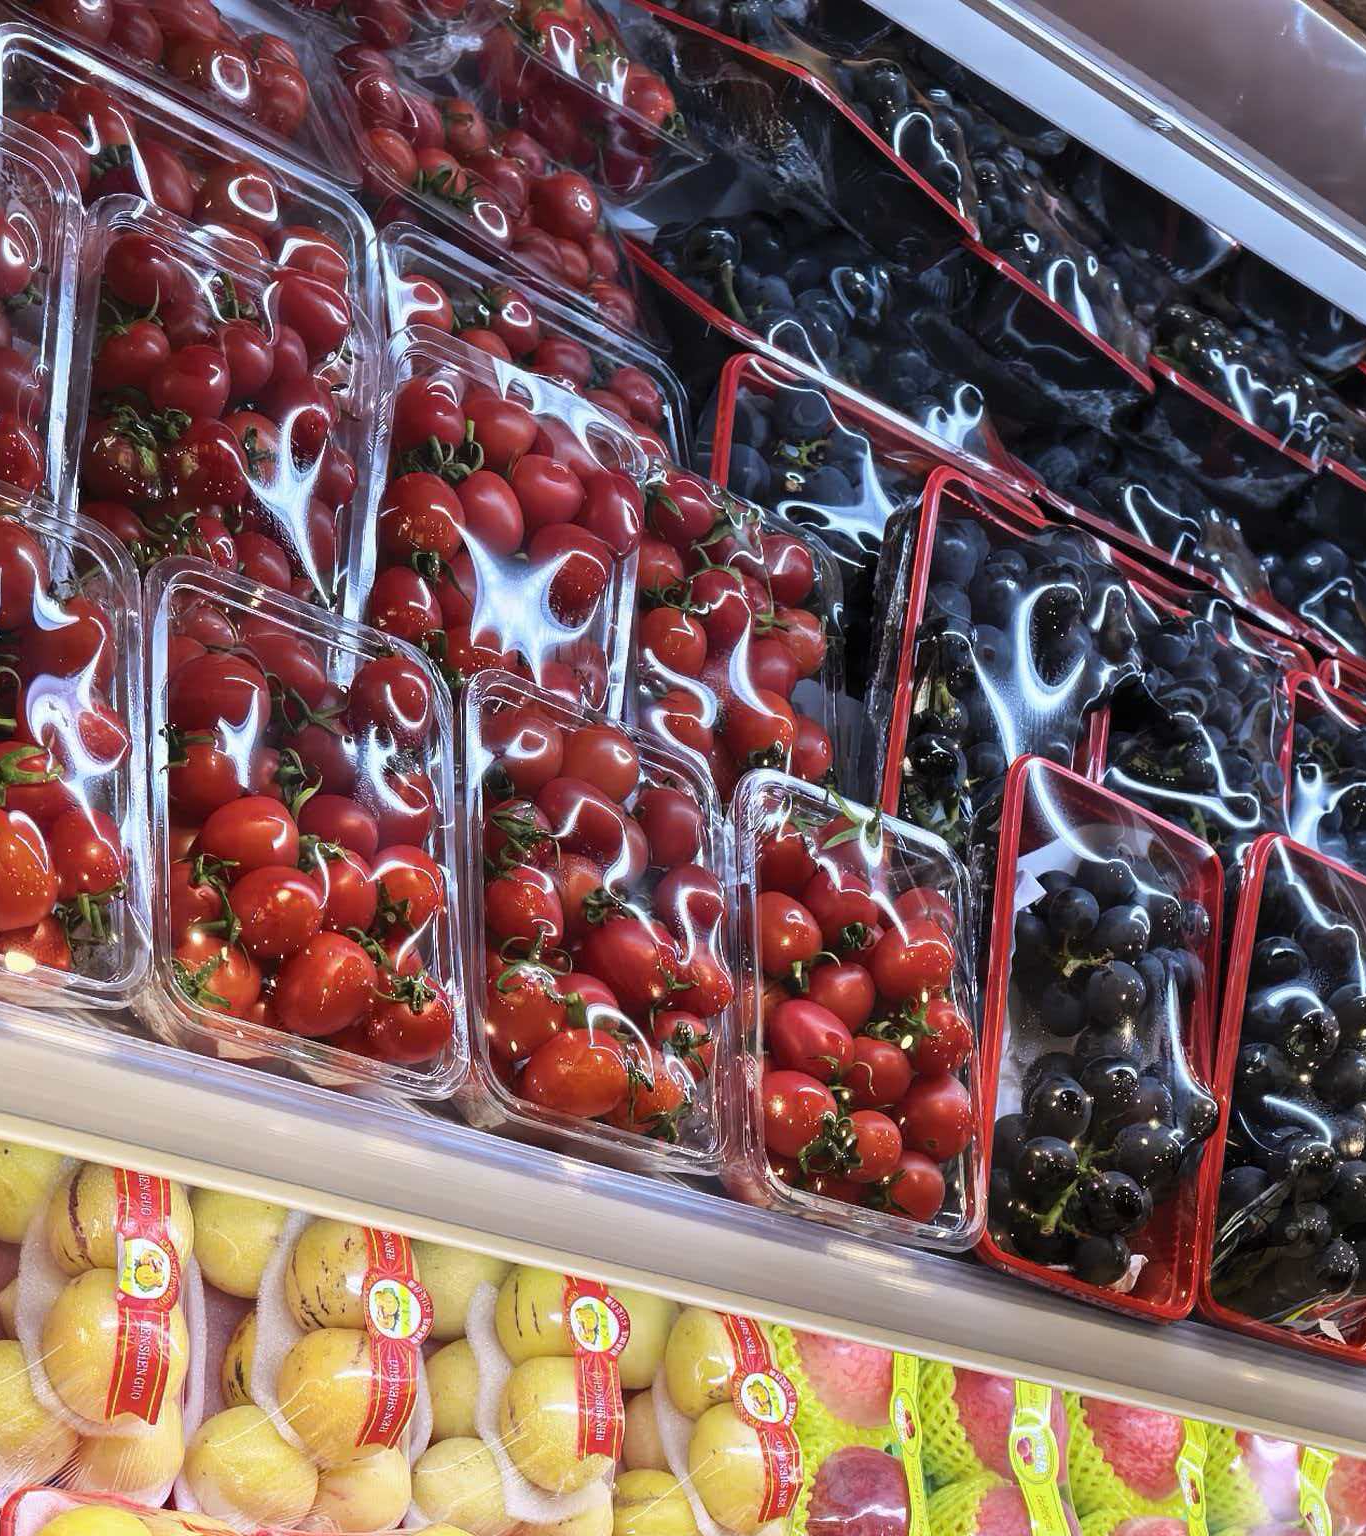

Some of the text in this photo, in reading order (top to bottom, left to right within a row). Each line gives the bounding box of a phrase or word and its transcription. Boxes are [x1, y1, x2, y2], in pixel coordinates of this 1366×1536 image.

[131, 1320, 152, 1400] REN SHEN GUO
[379, 1412, 393, 1432] REN
[387, 1383, 400, 1412] SHEN
